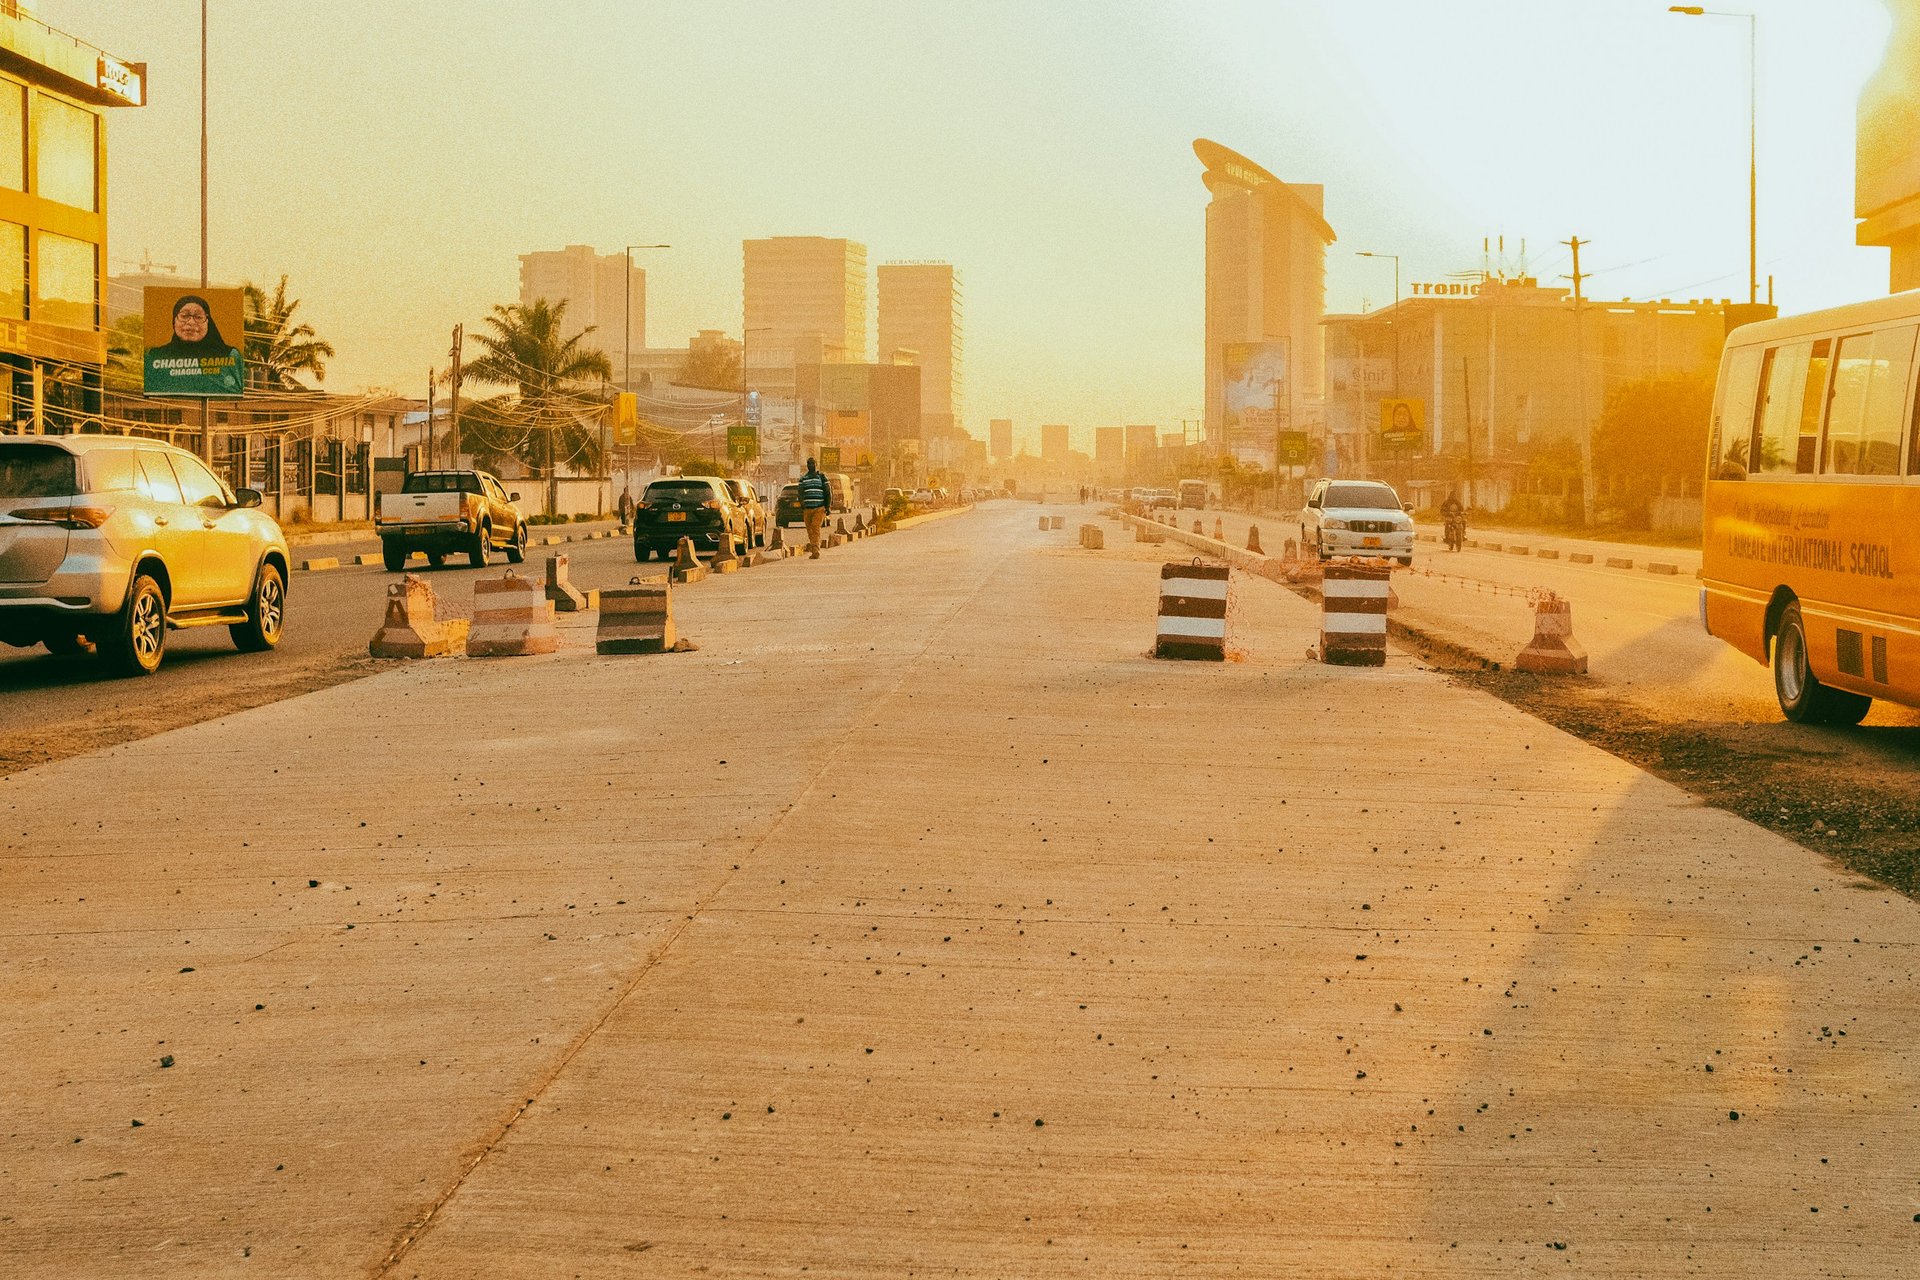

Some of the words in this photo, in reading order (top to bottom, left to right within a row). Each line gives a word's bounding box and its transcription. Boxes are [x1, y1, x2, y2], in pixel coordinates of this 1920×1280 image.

[153, 358, 199, 369] CHAGUA
[200, 357, 236, 367] SAMIA
[169, 367, 202, 376] CHAGUA
[202, 367, 220, 375] CCM
[1768, 535, 1845, 573] INTERNATIONAL
[1849, 542, 1894, 579] SCHOOL
